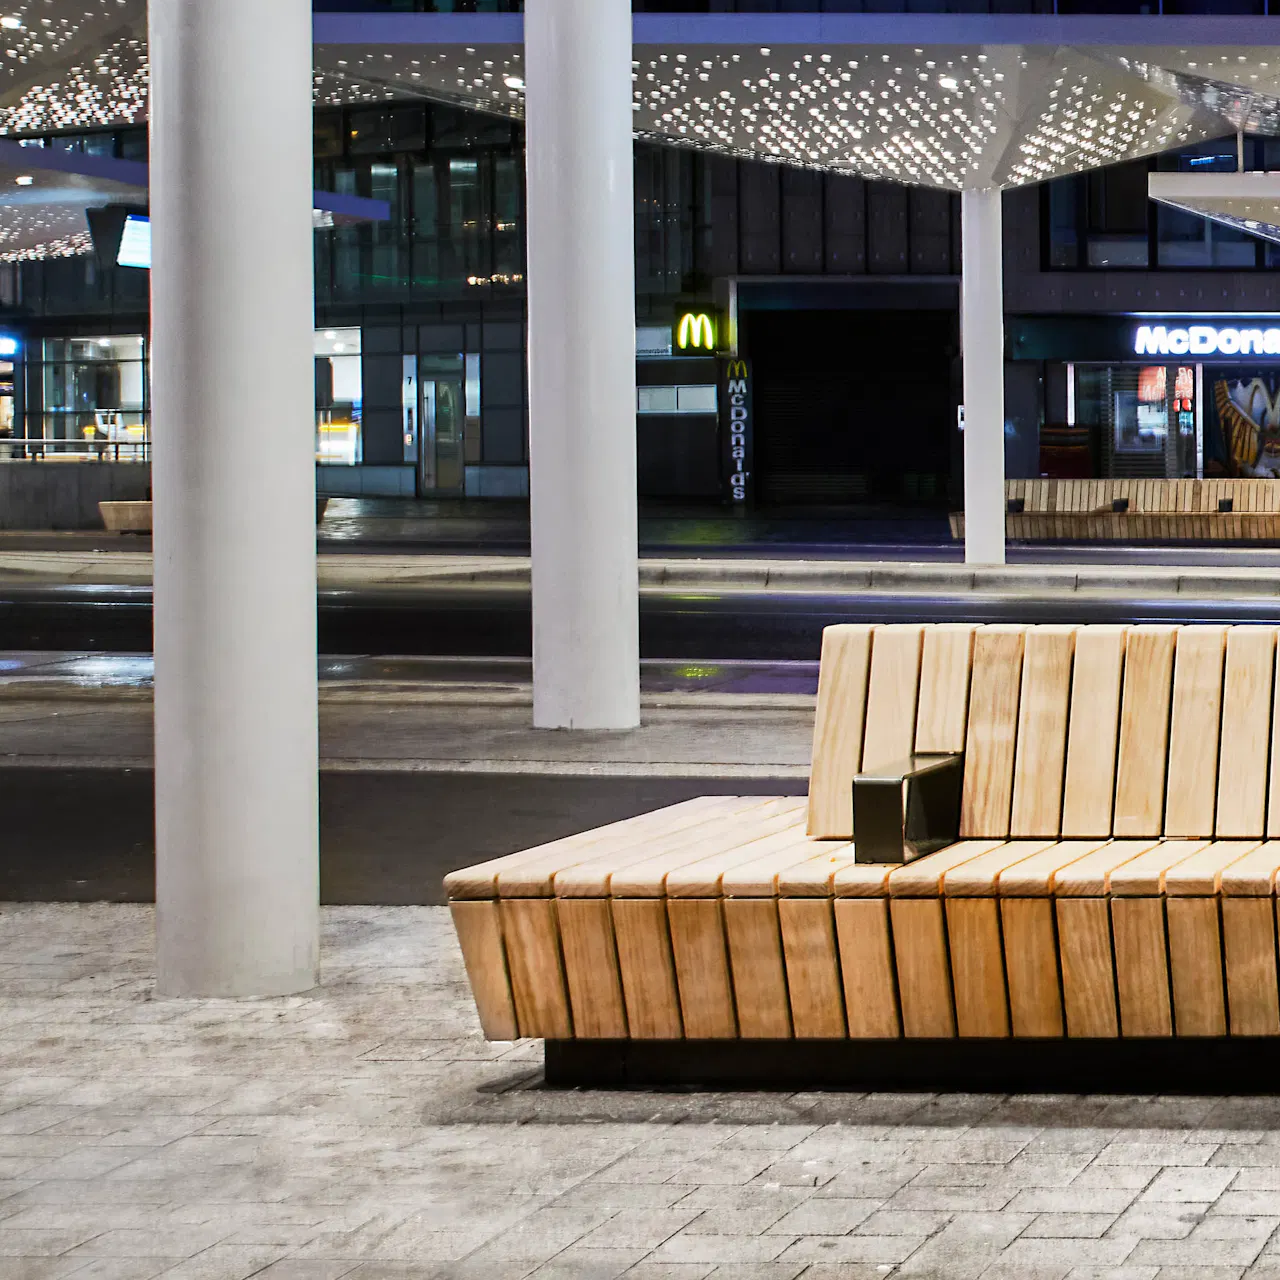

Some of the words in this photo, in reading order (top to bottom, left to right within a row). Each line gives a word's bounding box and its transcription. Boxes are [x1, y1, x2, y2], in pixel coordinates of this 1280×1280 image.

[635, 347, 669, 355] ommerzbank
[407, 376, 413, 385] 7
[727, 379, 750, 500] McDonald's
